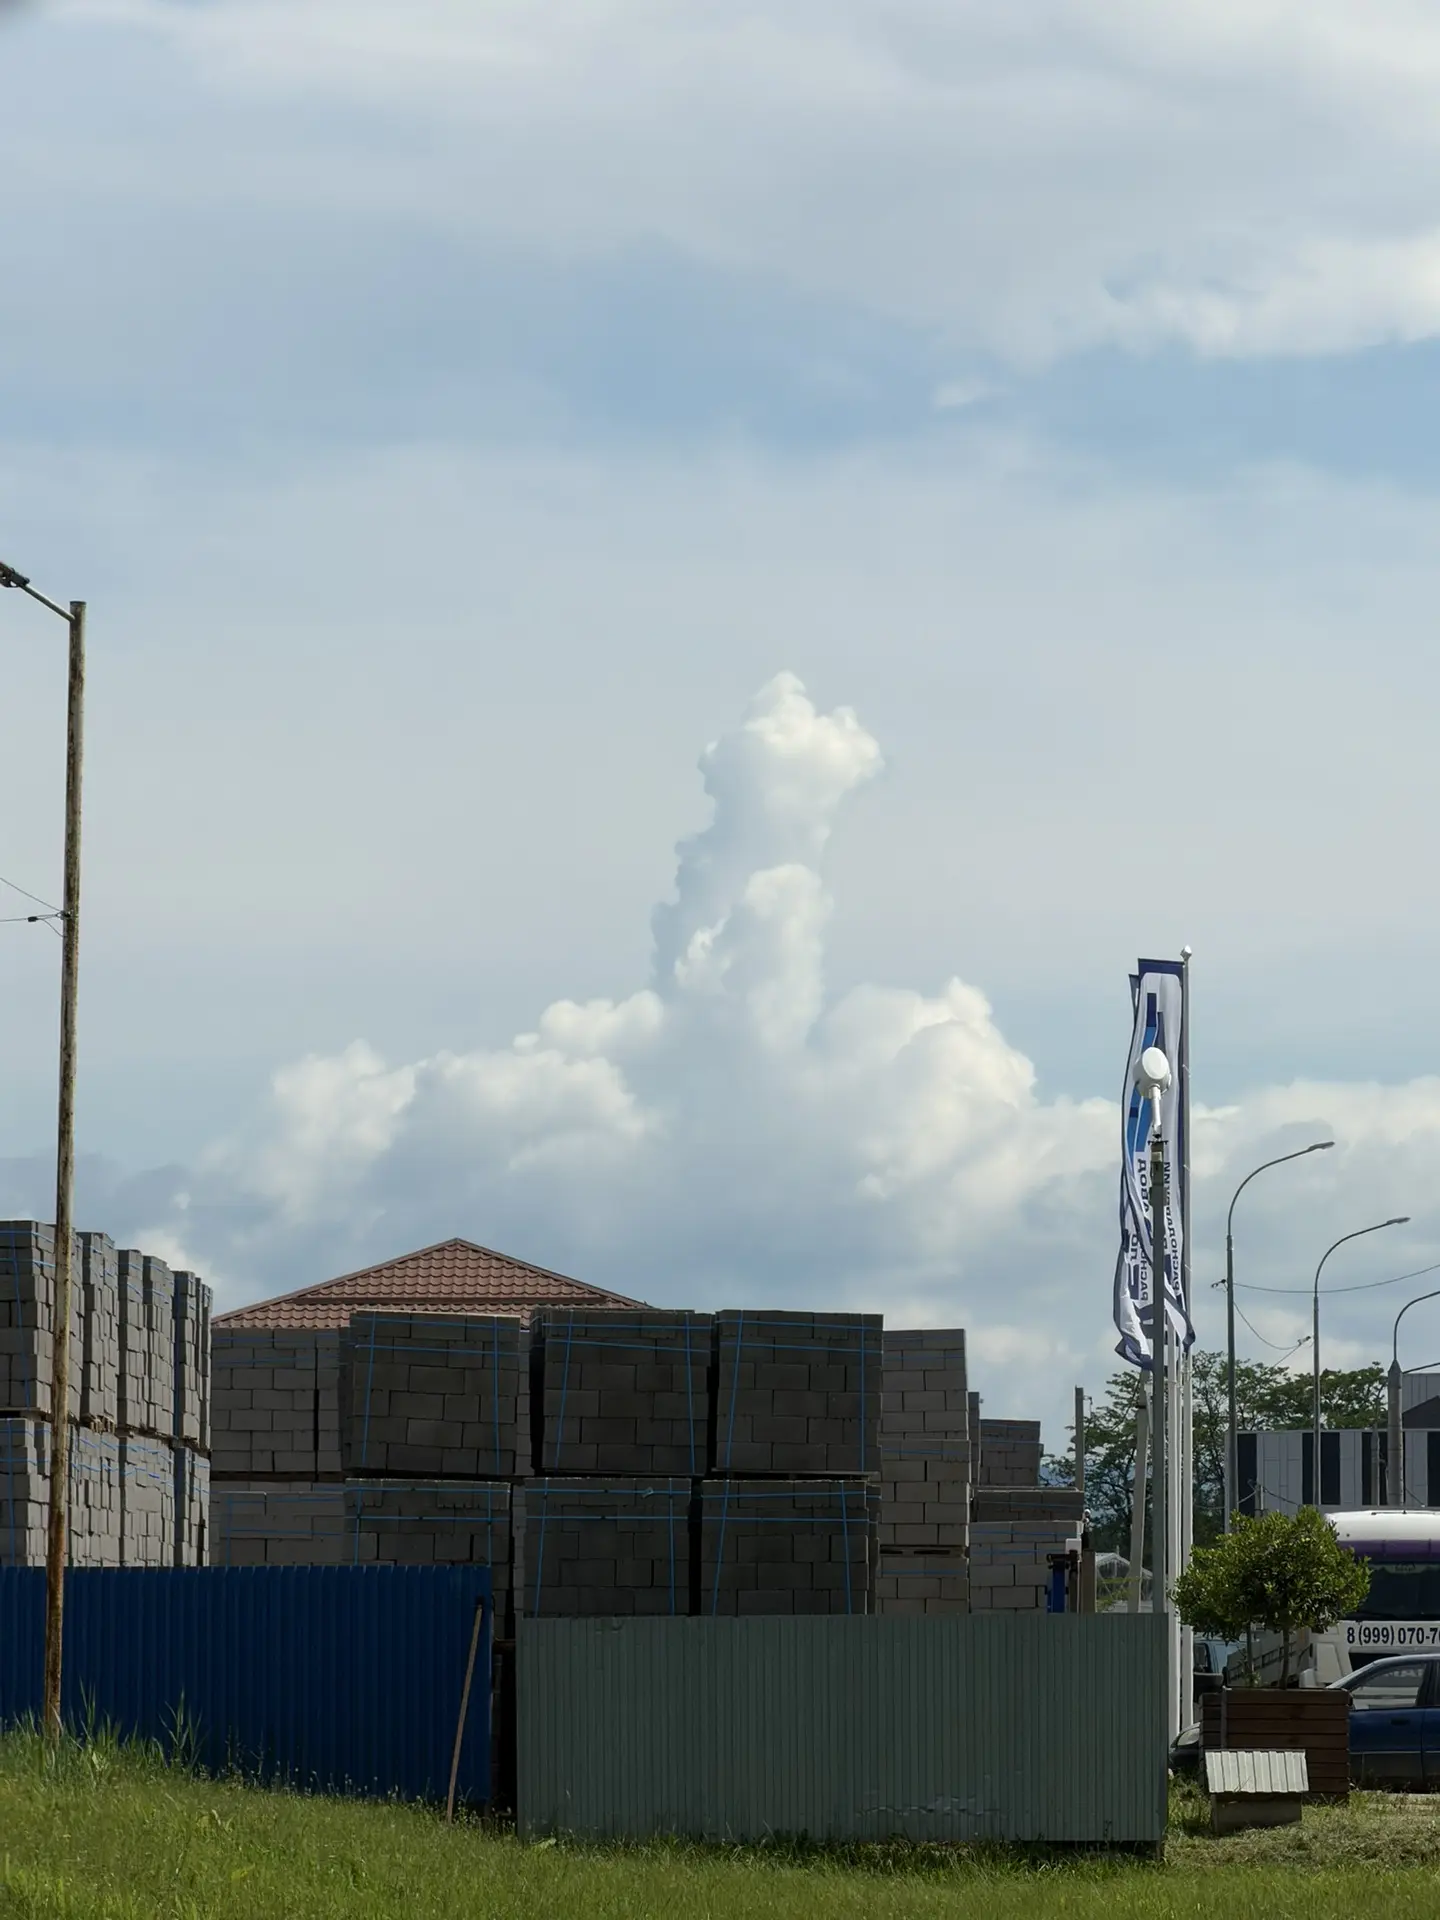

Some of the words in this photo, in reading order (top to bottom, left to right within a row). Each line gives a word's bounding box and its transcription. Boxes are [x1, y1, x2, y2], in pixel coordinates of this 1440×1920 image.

[1347, 1627, 1355, 1644] 8
[1359, 1625, 1394, 1645] (999)
[1398, 1627, 1440, 1644] 070-7
